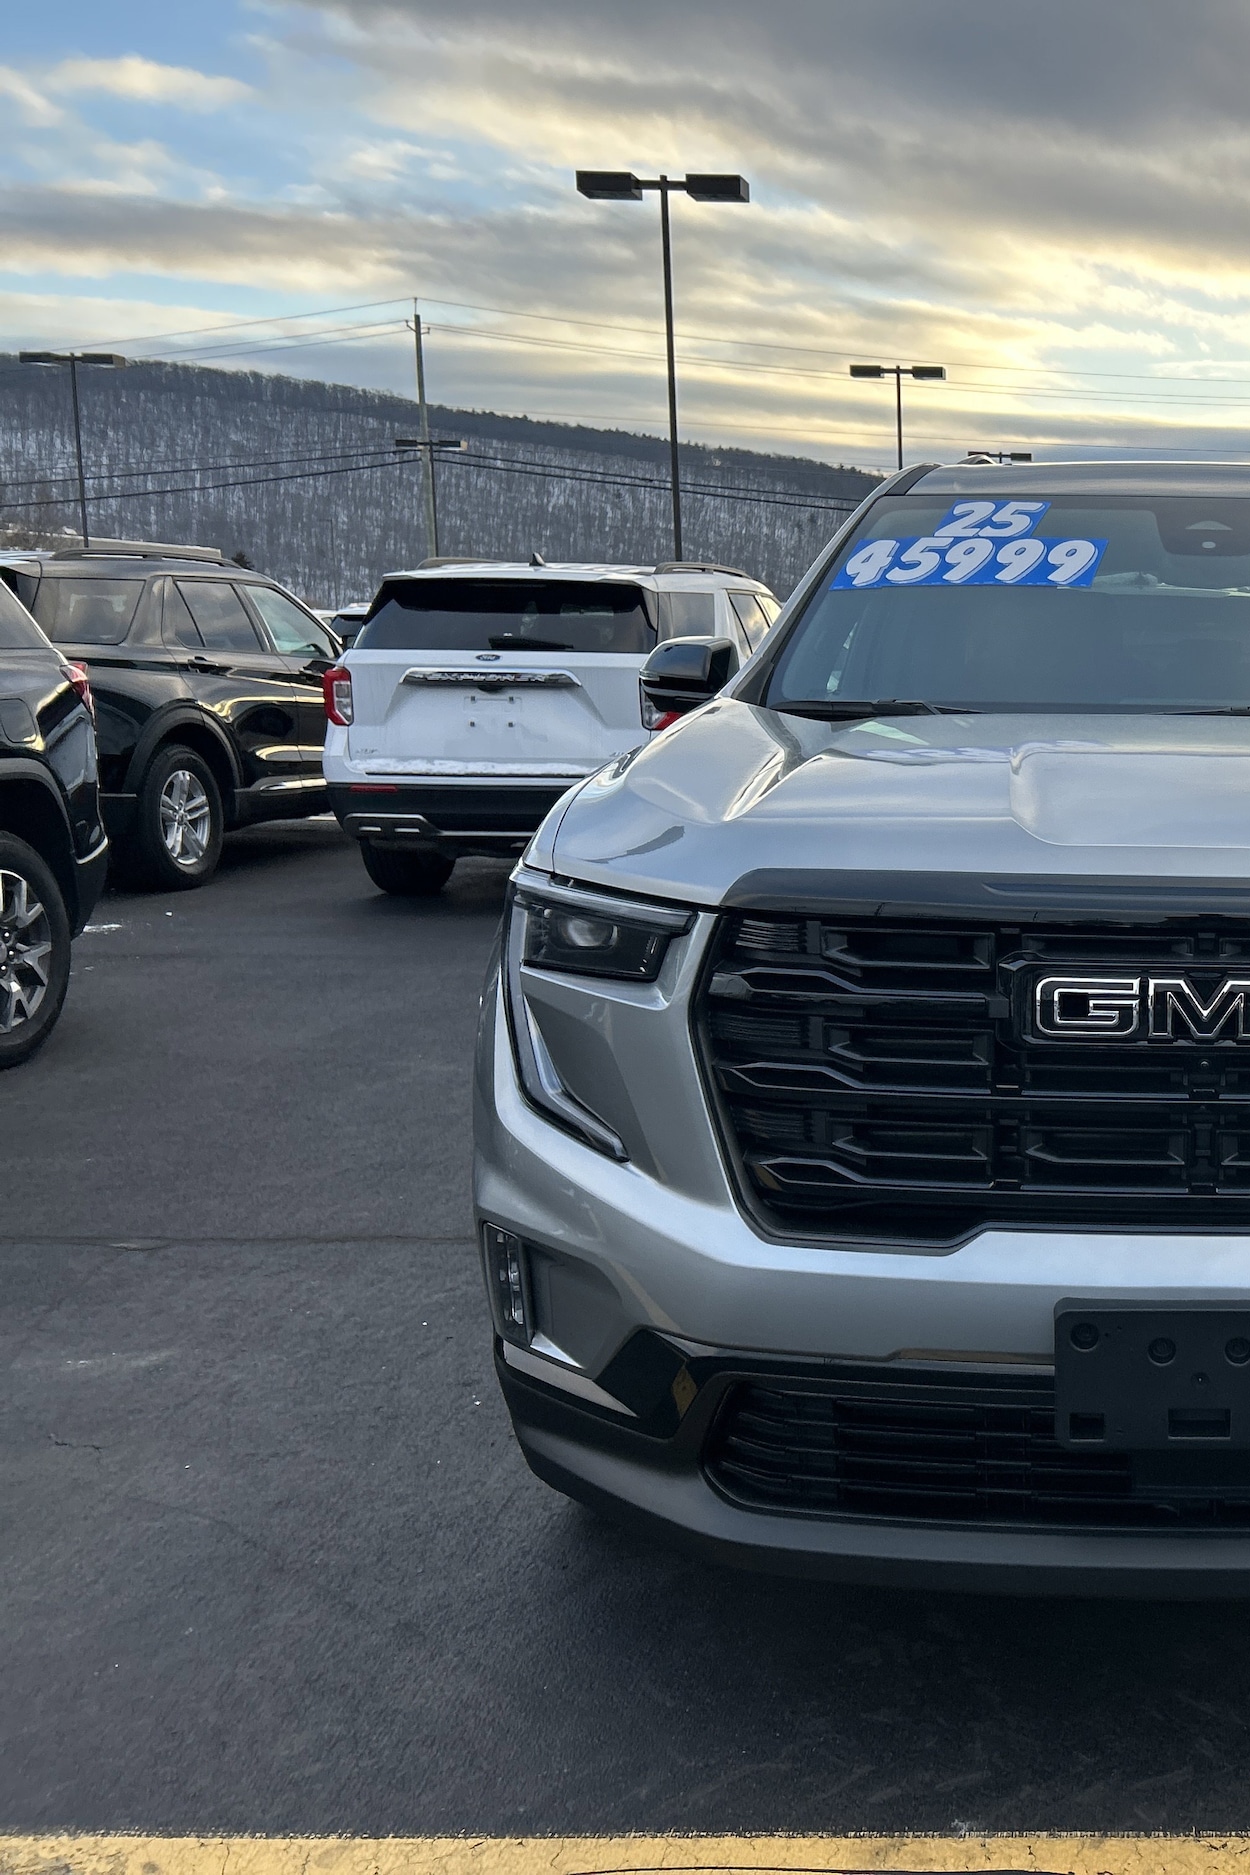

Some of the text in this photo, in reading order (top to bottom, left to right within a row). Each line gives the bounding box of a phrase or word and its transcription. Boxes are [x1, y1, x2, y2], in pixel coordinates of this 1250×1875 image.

[934, 501, 1045, 537] 25
[846, 537, 1099, 586] 45999
[426, 672, 545, 683] EXPLORER
